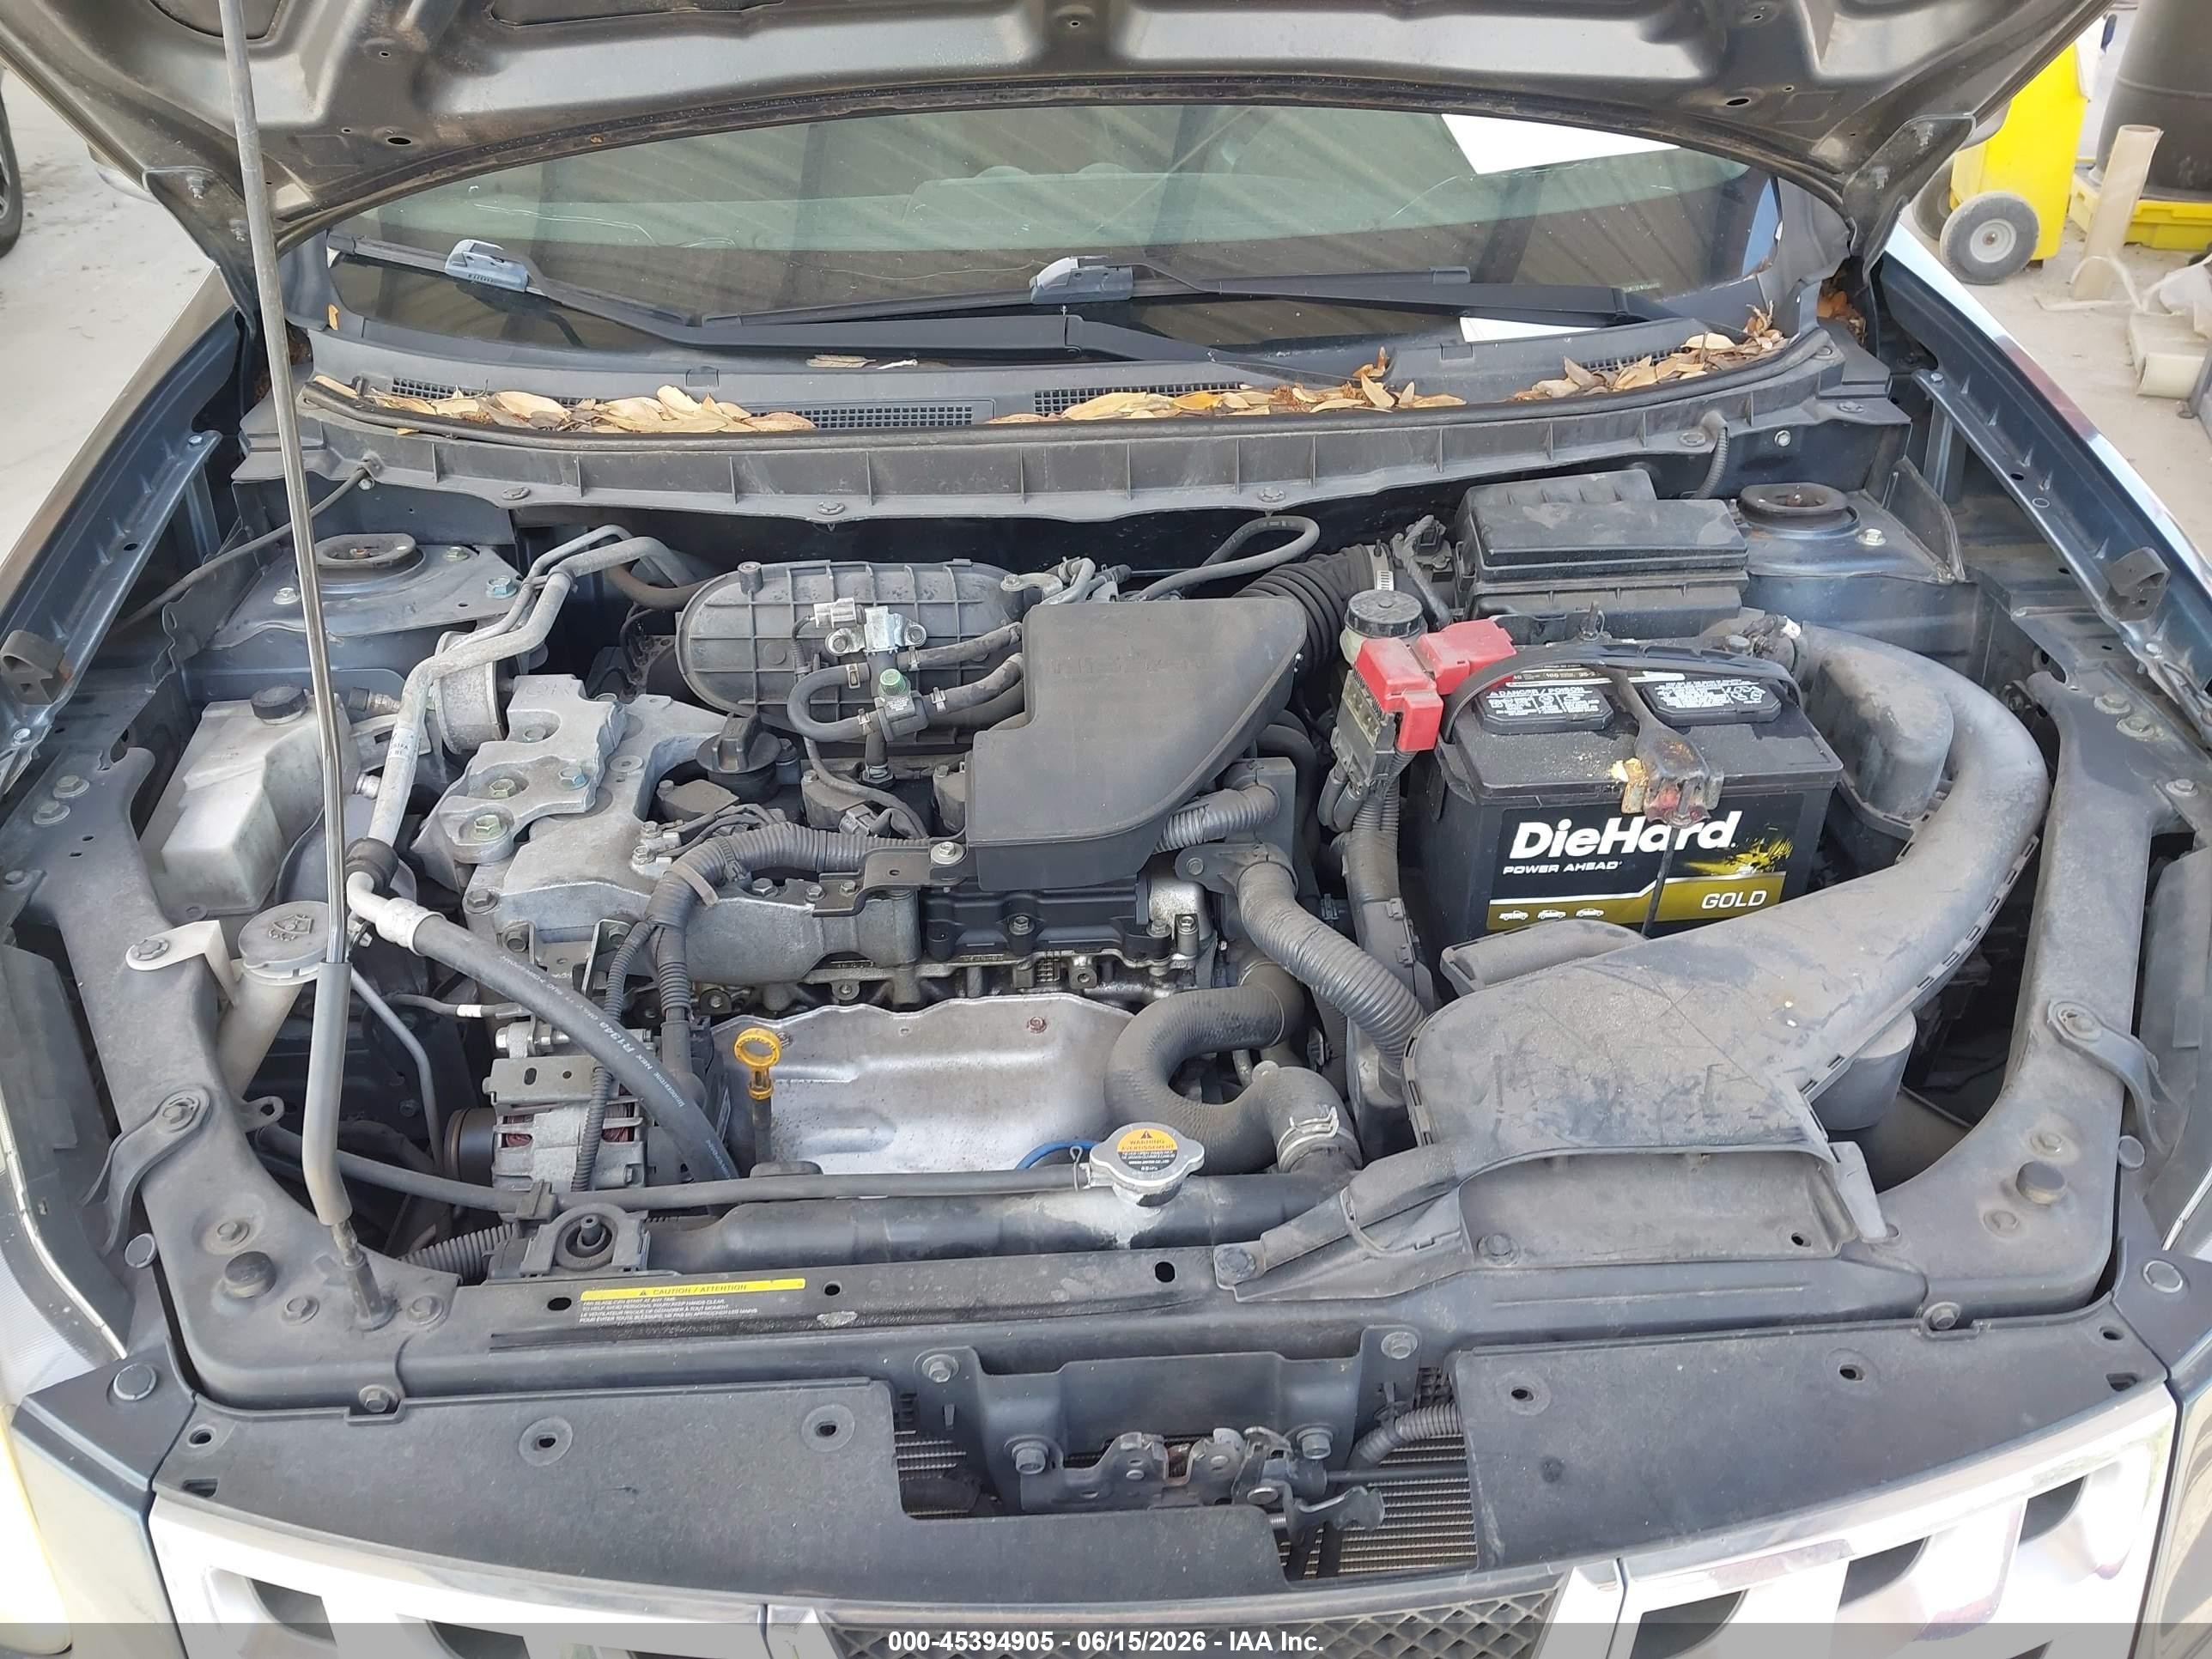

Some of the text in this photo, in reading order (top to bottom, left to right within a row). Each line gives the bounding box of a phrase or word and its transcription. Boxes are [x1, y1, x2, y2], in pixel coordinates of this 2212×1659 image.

[1503, 864, 1559, 874] POWER
[1701, 890, 1767, 909] GOLD
[599, 1022, 635, 1053] R134a
[653, 1287, 691, 1296] CAUTION
[700, 1284, 747, 1292] ATTENTION
